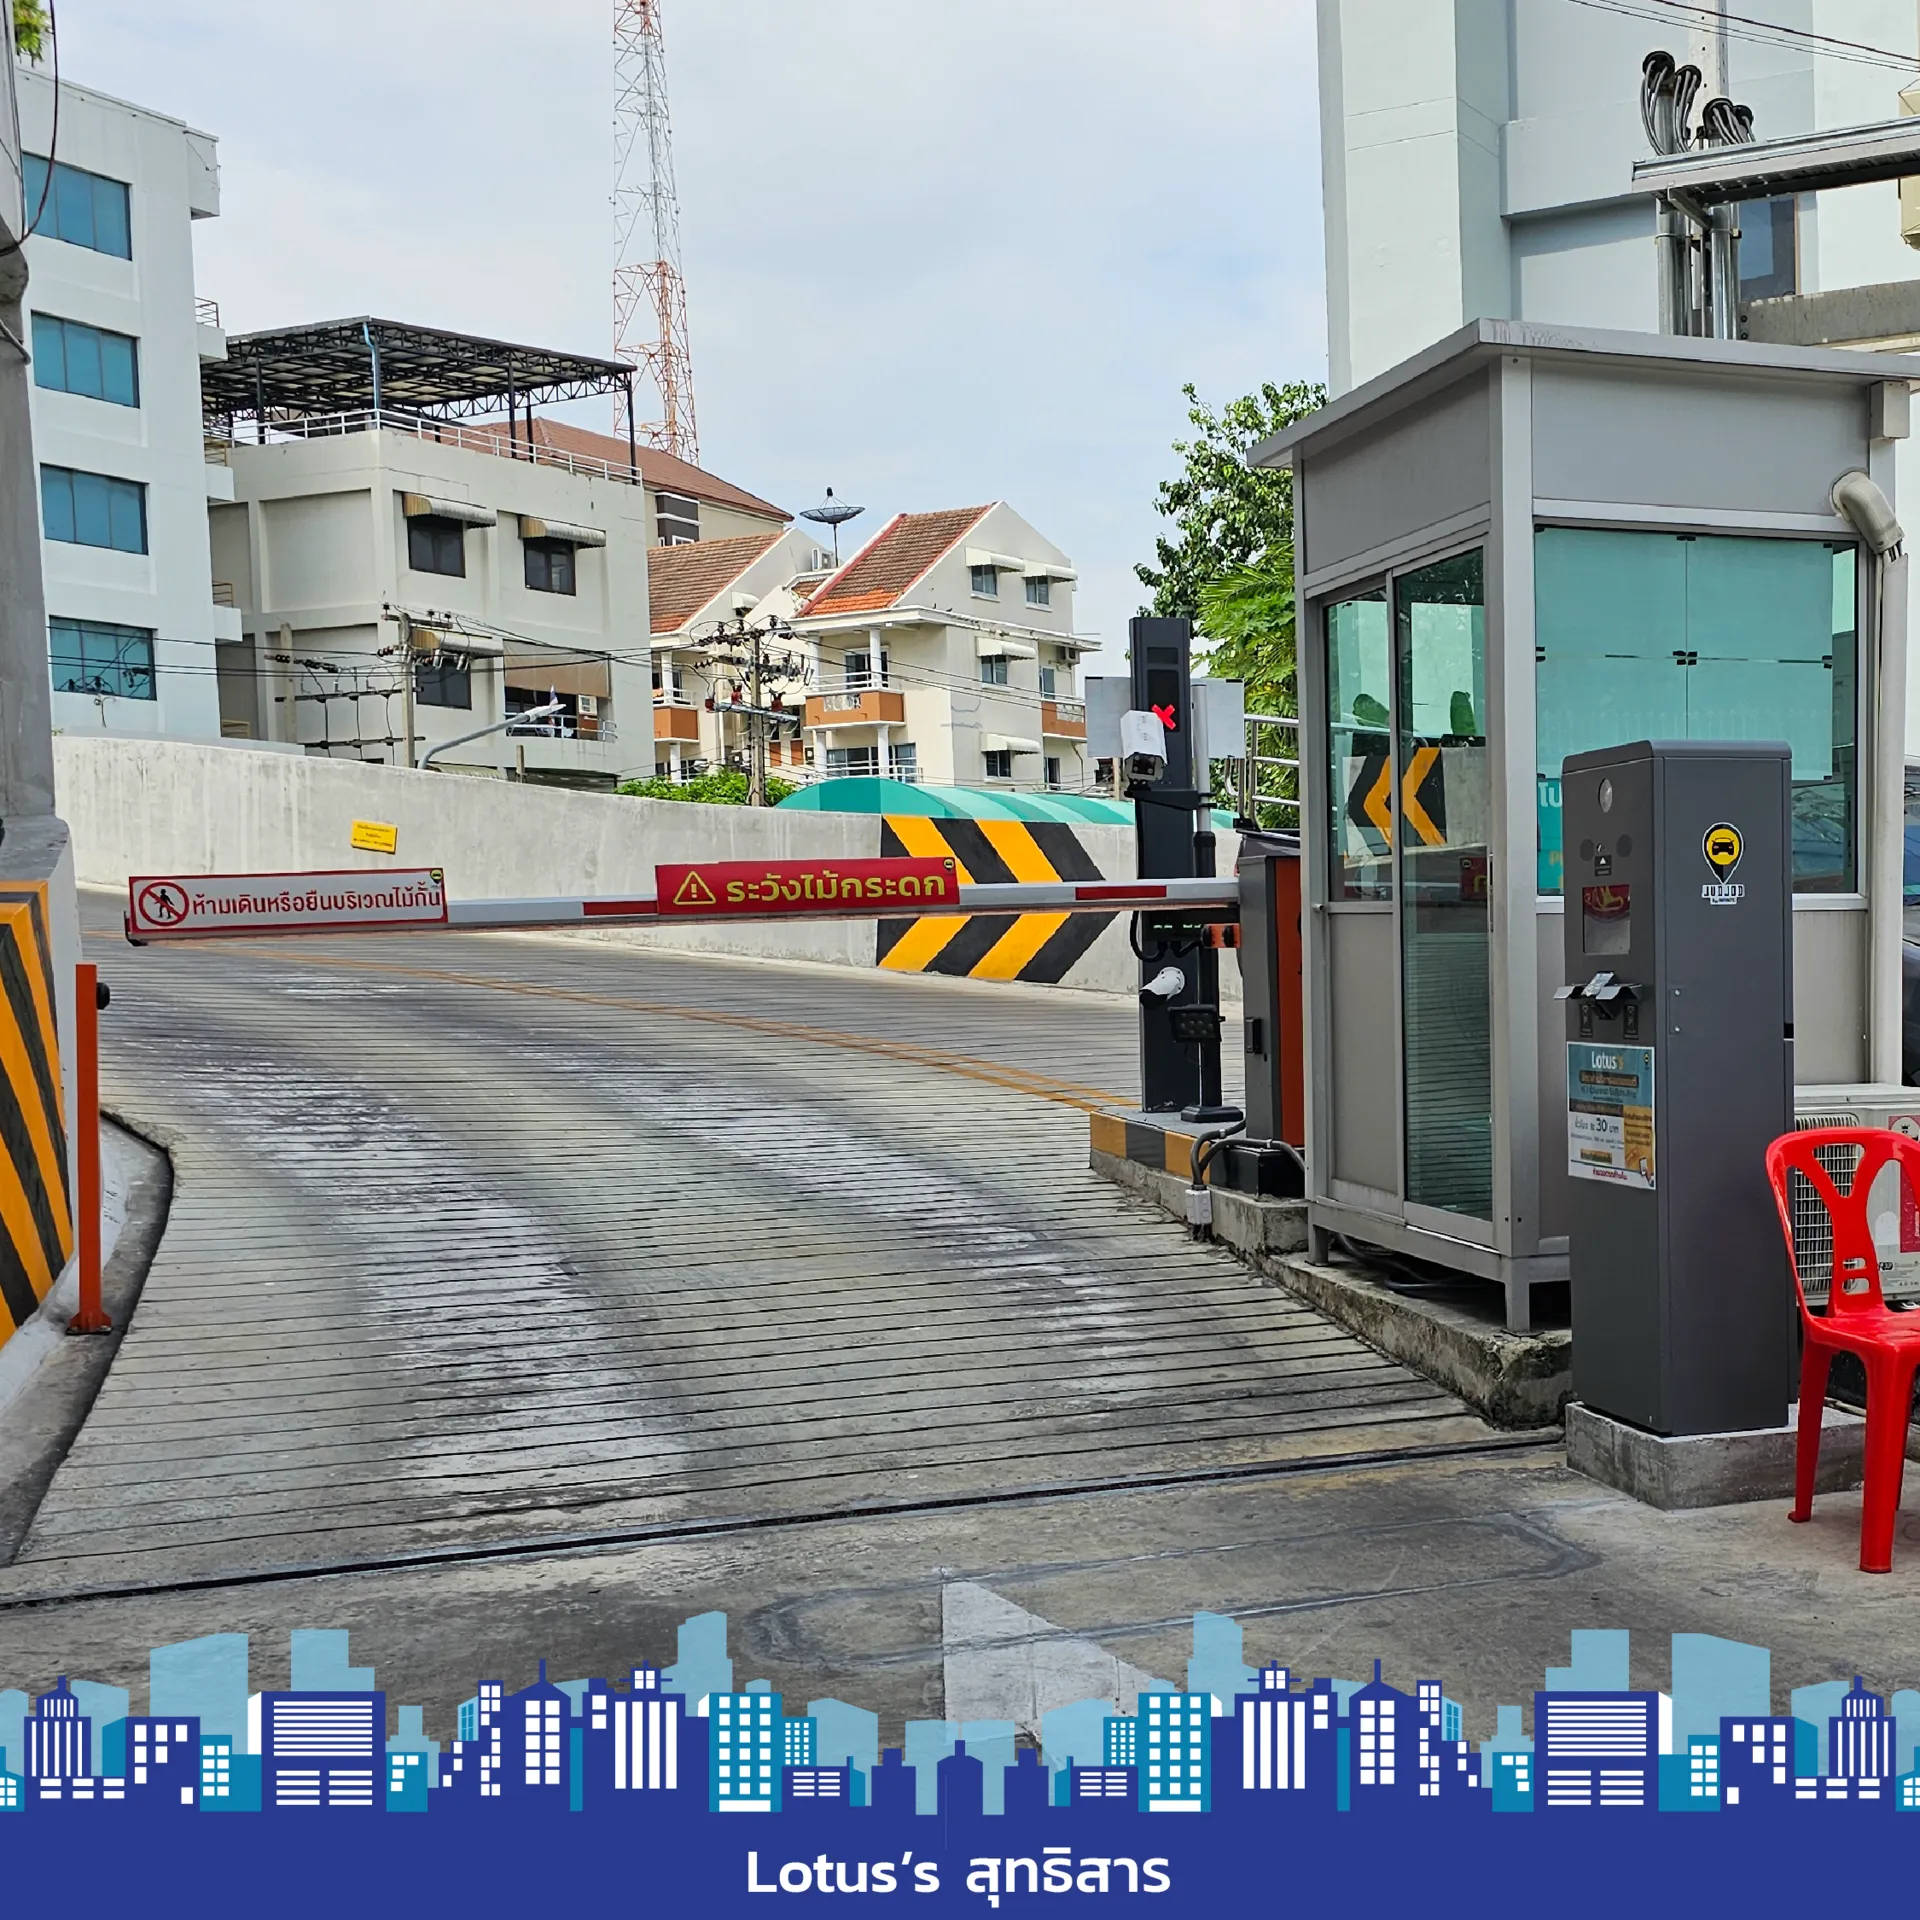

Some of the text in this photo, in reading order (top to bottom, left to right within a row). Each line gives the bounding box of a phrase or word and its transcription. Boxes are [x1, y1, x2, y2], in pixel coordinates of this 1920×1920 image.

[193, 881, 440, 914] ห้ามเดินหรือยืนบริเวณไม้กั้น
[727, 870, 945, 902] ระวังไม้กระดก
[1703, 885, 1743, 897] JUDJOD
[1595, 1118, 1608, 1133] 30
